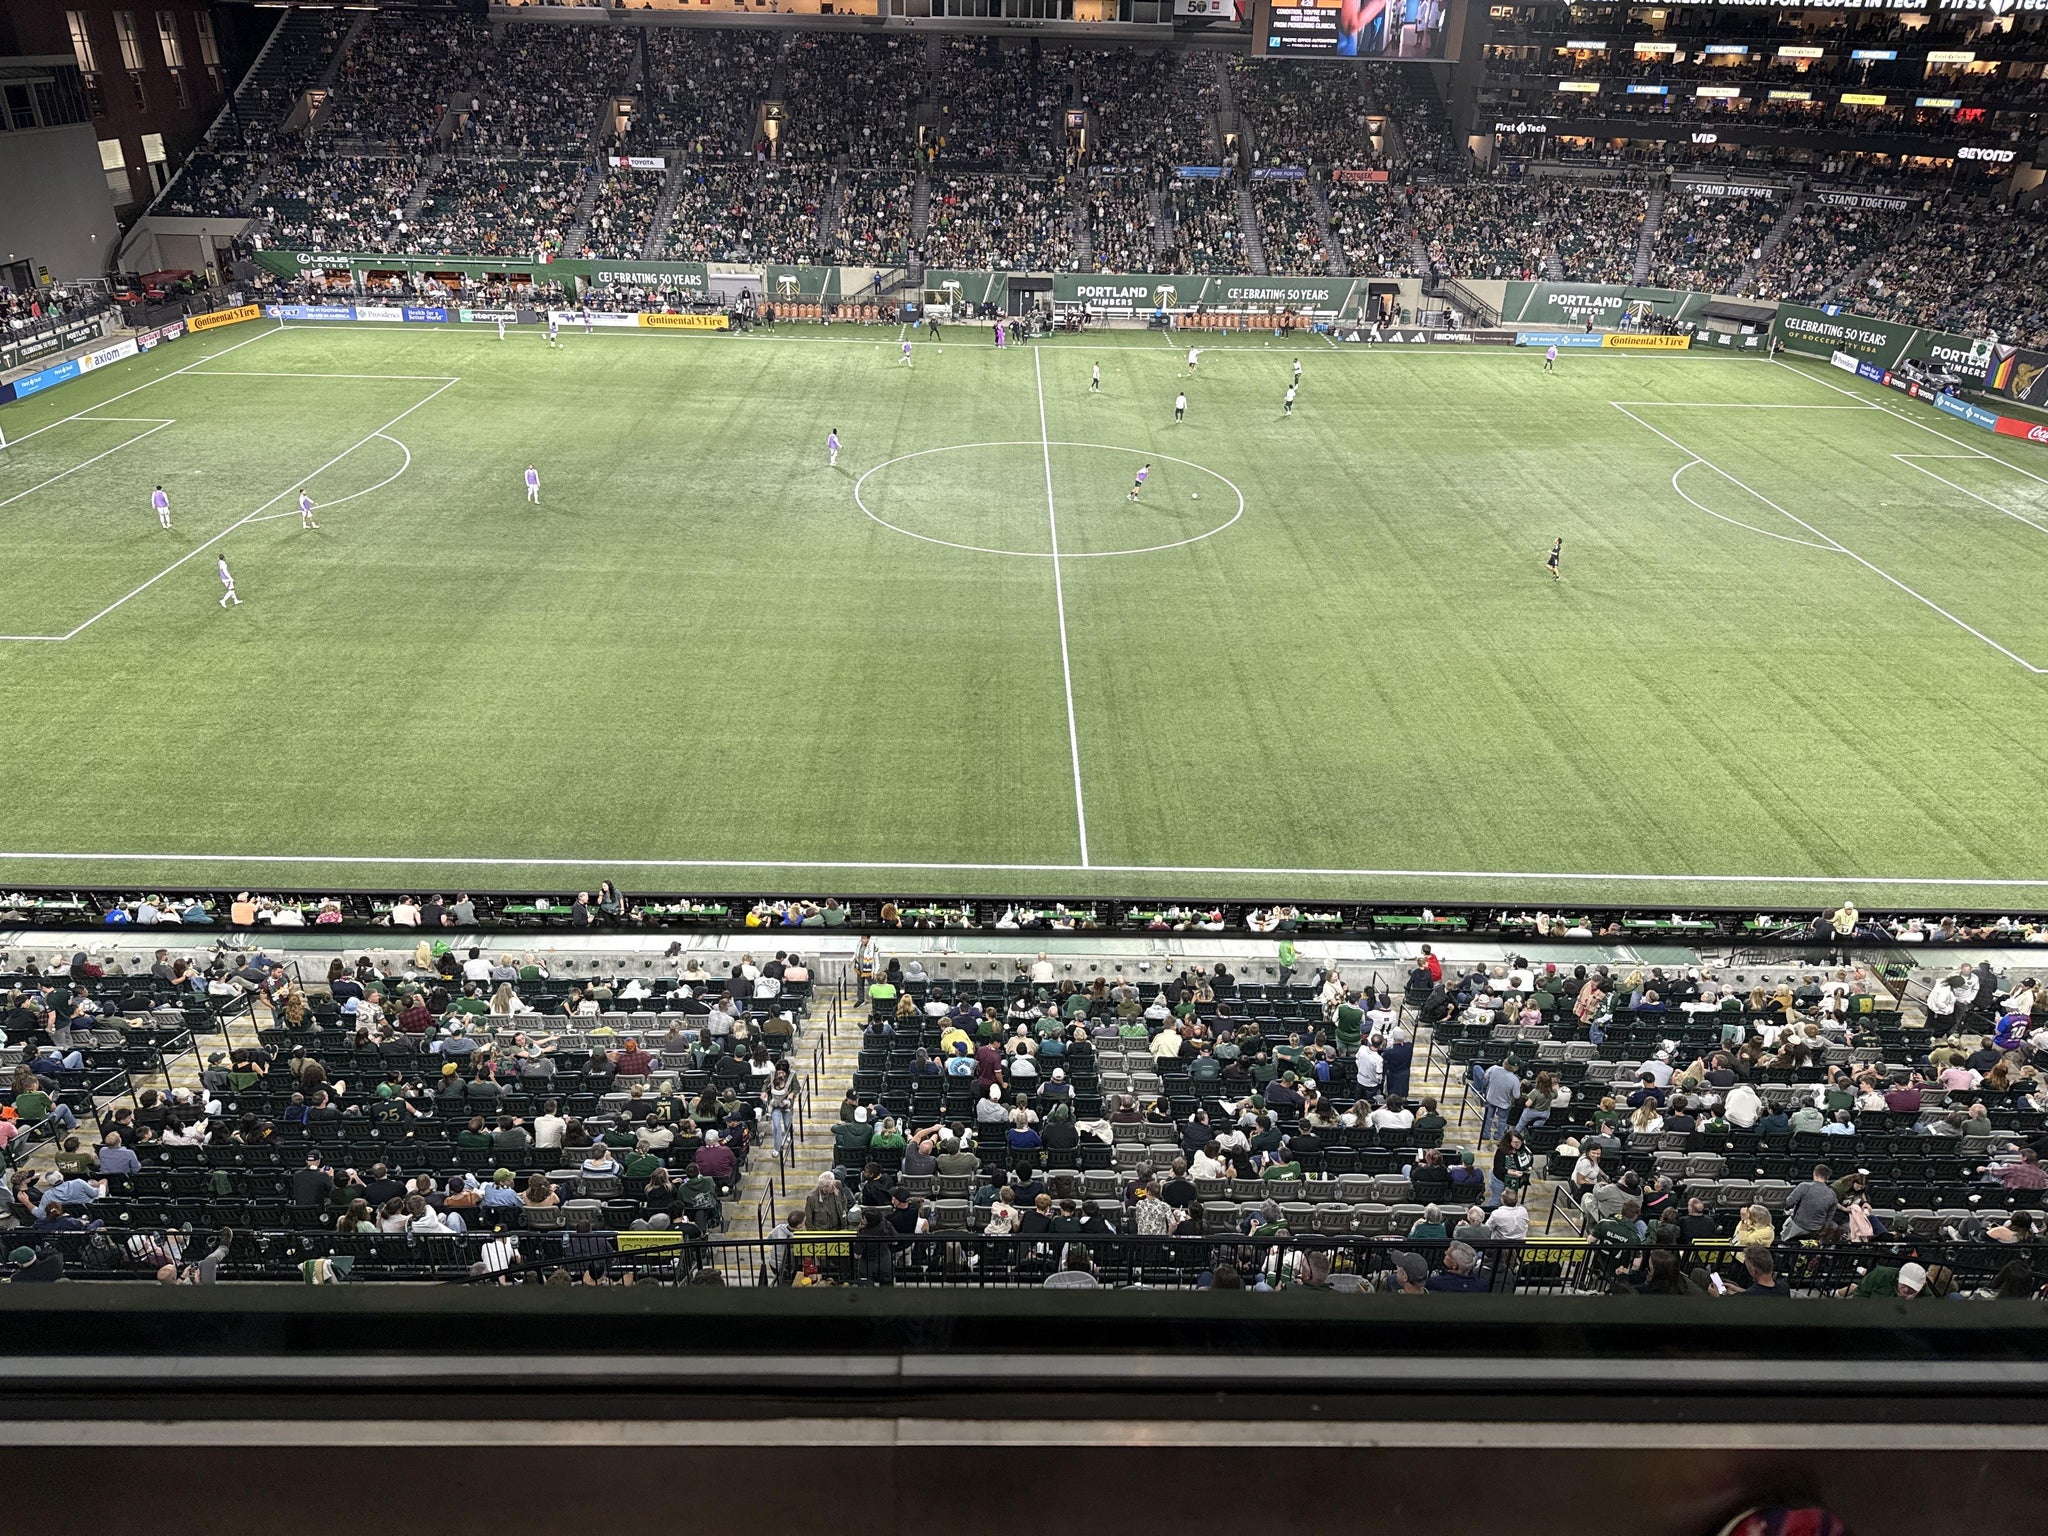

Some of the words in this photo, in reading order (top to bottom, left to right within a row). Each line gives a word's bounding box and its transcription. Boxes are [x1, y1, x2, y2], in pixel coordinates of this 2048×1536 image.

[1495, 123, 1515, 132] First
[1526, 124, 1547, 133] Tech
[1691, 133, 1717, 143] VIP
[1957, 147, 2016, 162] BEYOND
[1696, 184, 1724, 195] STAND
[1828, 194, 1859, 206] STAND
[1860, 196, 1907, 210] TOGETHER
[598, 271, 658, 285] CELEBRATING
[659, 274, 671, 285] 50
[673, 274, 702, 286] YEARS
[1077, 286, 1148, 298] PORTLAND
[1228, 288, 1286, 300] CELEBRATING
[1287, 289, 1300, 300] 50
[1301, 289, 1329, 301] YEARS
[1092, 298, 1133, 306] TIMBERS
[1548, 294, 1623, 308] PORTLAND
[194, 312, 234, 329] Continental
[239, 307, 255, 318] Tire
[367, 309, 400, 318] Providence
[1562, 306, 1605, 316] TIMBERS
[647, 315, 695, 327] Continental
[700, 316, 723, 326] Tire
[162, 321, 184, 337] DISCOUNT
[1785, 317, 1843, 338] CELEBRATING
[1844, 327, 1857, 340] 50
[1858, 329, 1887, 346] YEARS
[1610, 335, 1657, 347] Continental
[1664, 336, 1684, 346] Tire
[1802, 333, 1835, 345] SOCCER
[1861, 344, 1877, 353] USA
[93, 347, 121, 366] axiom
[1944, 362, 1987, 379] TIMBERS
[1891, 377, 1907, 390] TOYOTA
[1918, 388, 1935, 402] TOYOTA
[656, 1106, 671, 1121] 21
